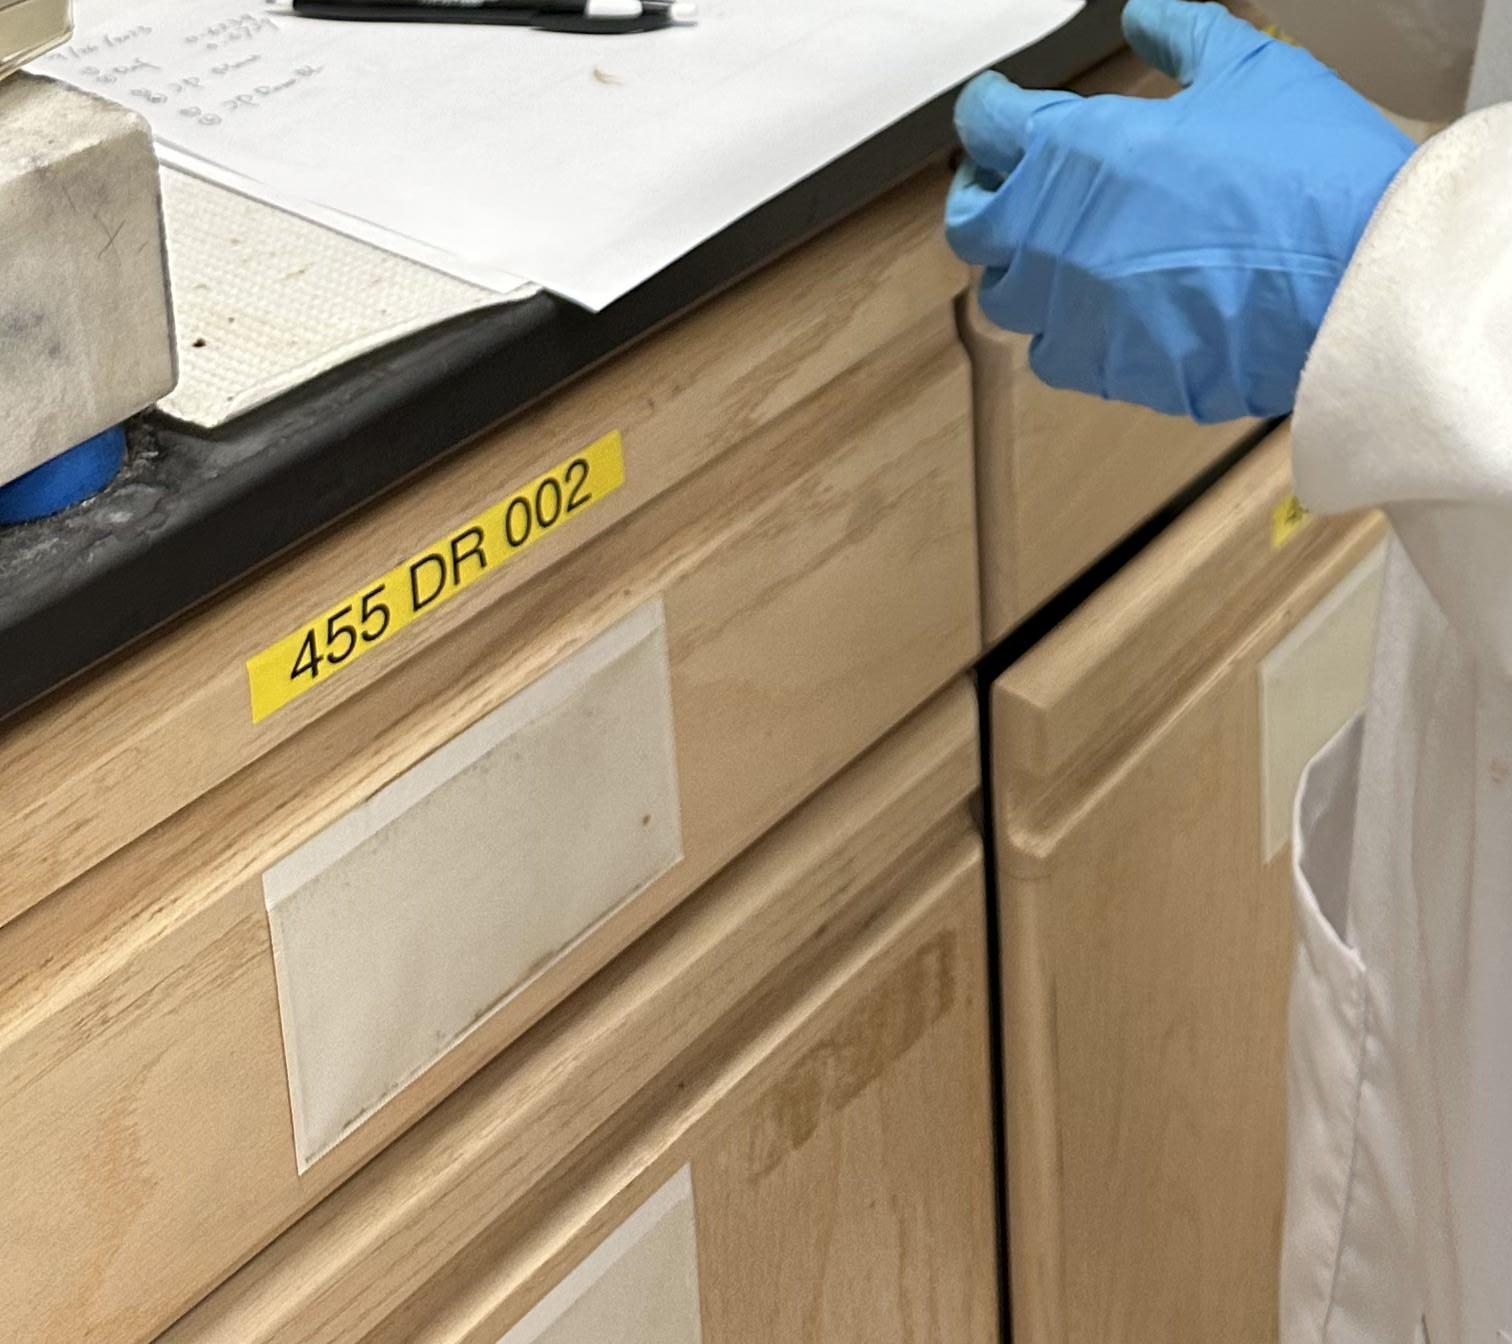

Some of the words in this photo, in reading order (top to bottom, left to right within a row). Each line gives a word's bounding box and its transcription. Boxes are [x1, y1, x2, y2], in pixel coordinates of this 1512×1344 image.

[289, 583, 391, 681] 455
[409, 526, 489, 612] DR
[504, 457, 593, 548] 002
